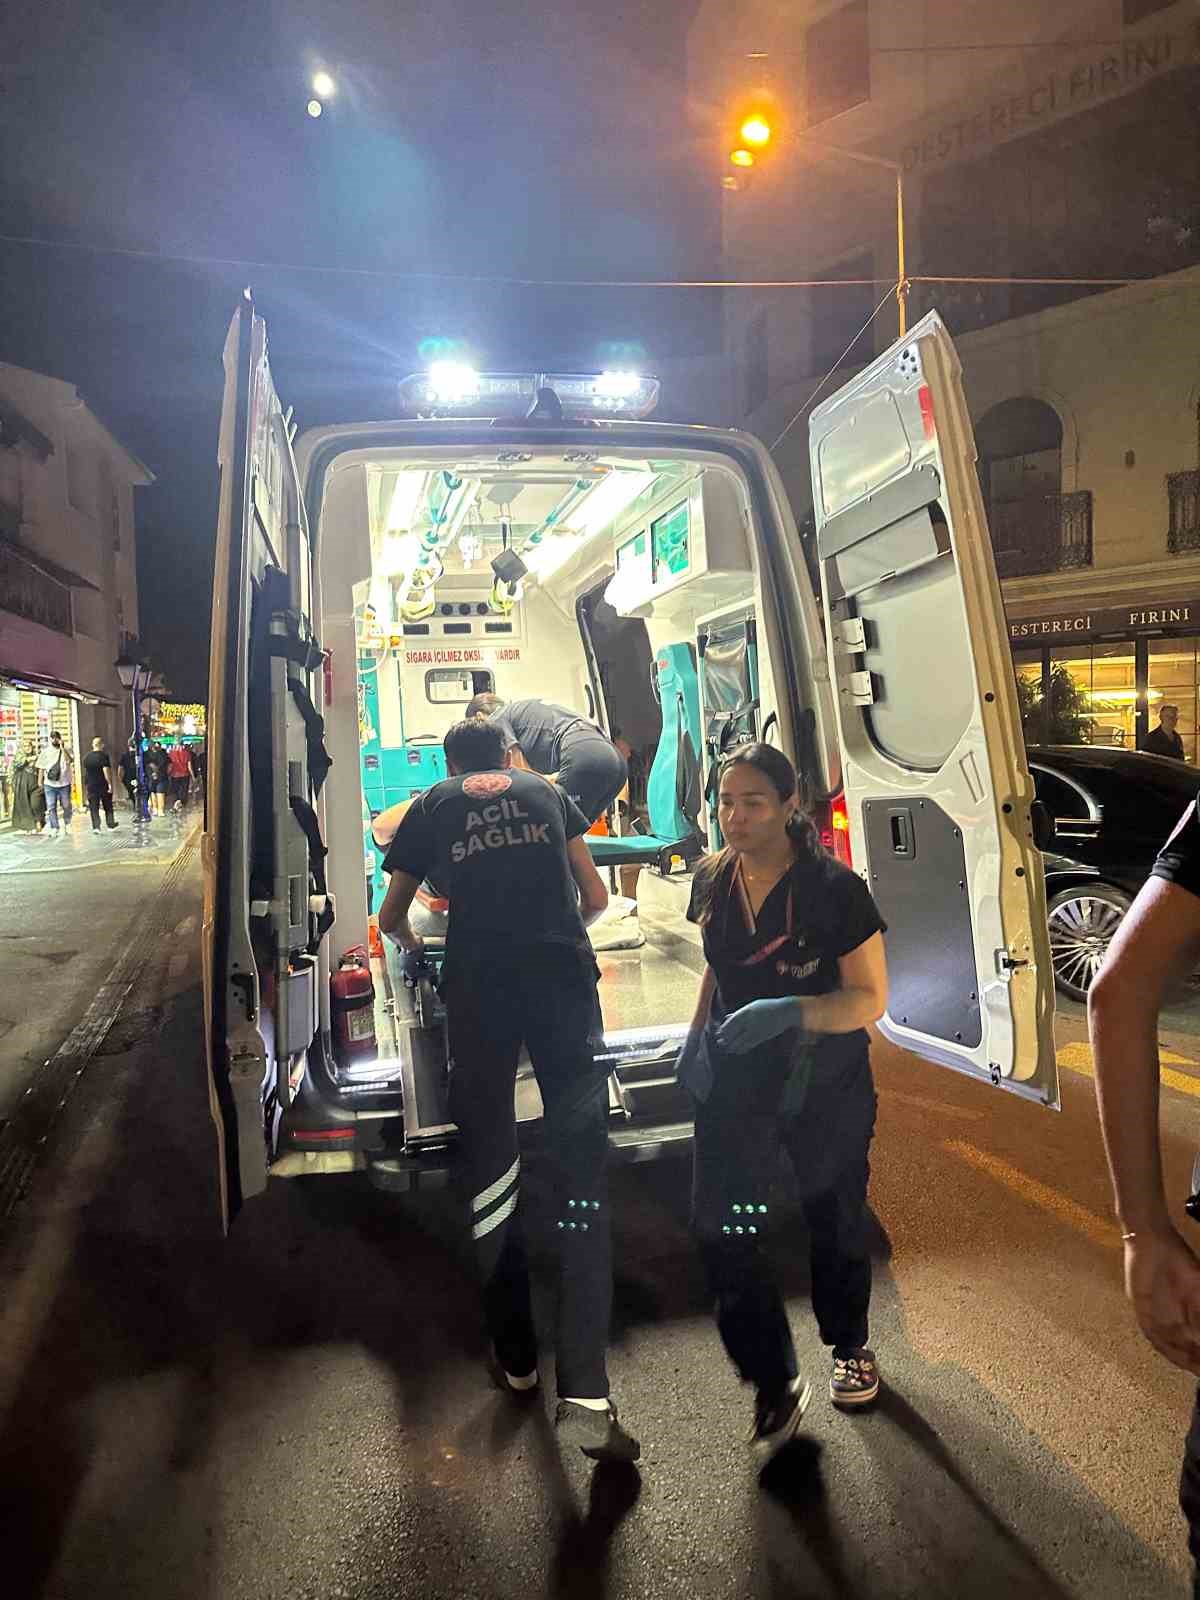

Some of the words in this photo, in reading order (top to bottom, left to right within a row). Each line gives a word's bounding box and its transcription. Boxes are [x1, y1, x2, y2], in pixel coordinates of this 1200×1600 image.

[1010, 615, 1091, 637] ESTERECİ
[1129, 607, 1191, 626] FIRINI
[451, 823, 550, 863] SAĞLIK
